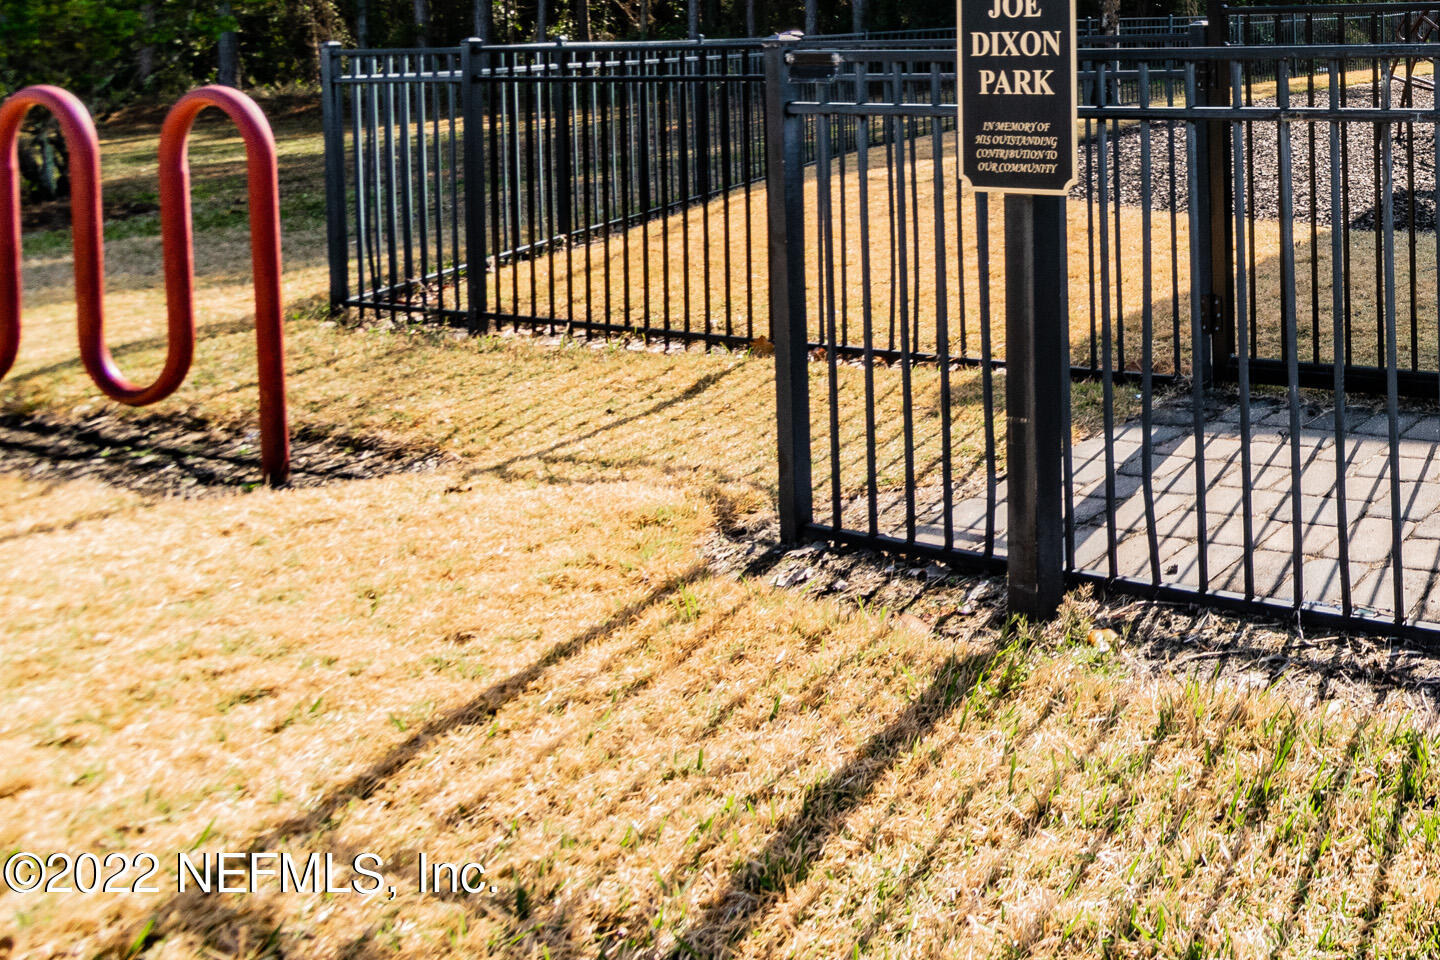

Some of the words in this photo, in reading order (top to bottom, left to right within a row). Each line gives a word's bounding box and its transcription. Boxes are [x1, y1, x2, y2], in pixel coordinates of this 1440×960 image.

[970, 31, 1062, 57] DIXON
[978, 69, 1056, 95] PARK
[983, 121, 995, 131] IN
[995, 122, 1037, 133] MEMORY
[1037, 122, 1051, 132] OF
[975, 134, 992, 145] HIS
[992, 135, 1058, 149] OUTSTANDING
[976, 148, 1045, 160] CONTRIBUTION
[1045, 150, 1058, 160] TO
[978, 162, 999, 173] OUR
[998, 162, 1058, 174] COMMUNITY
